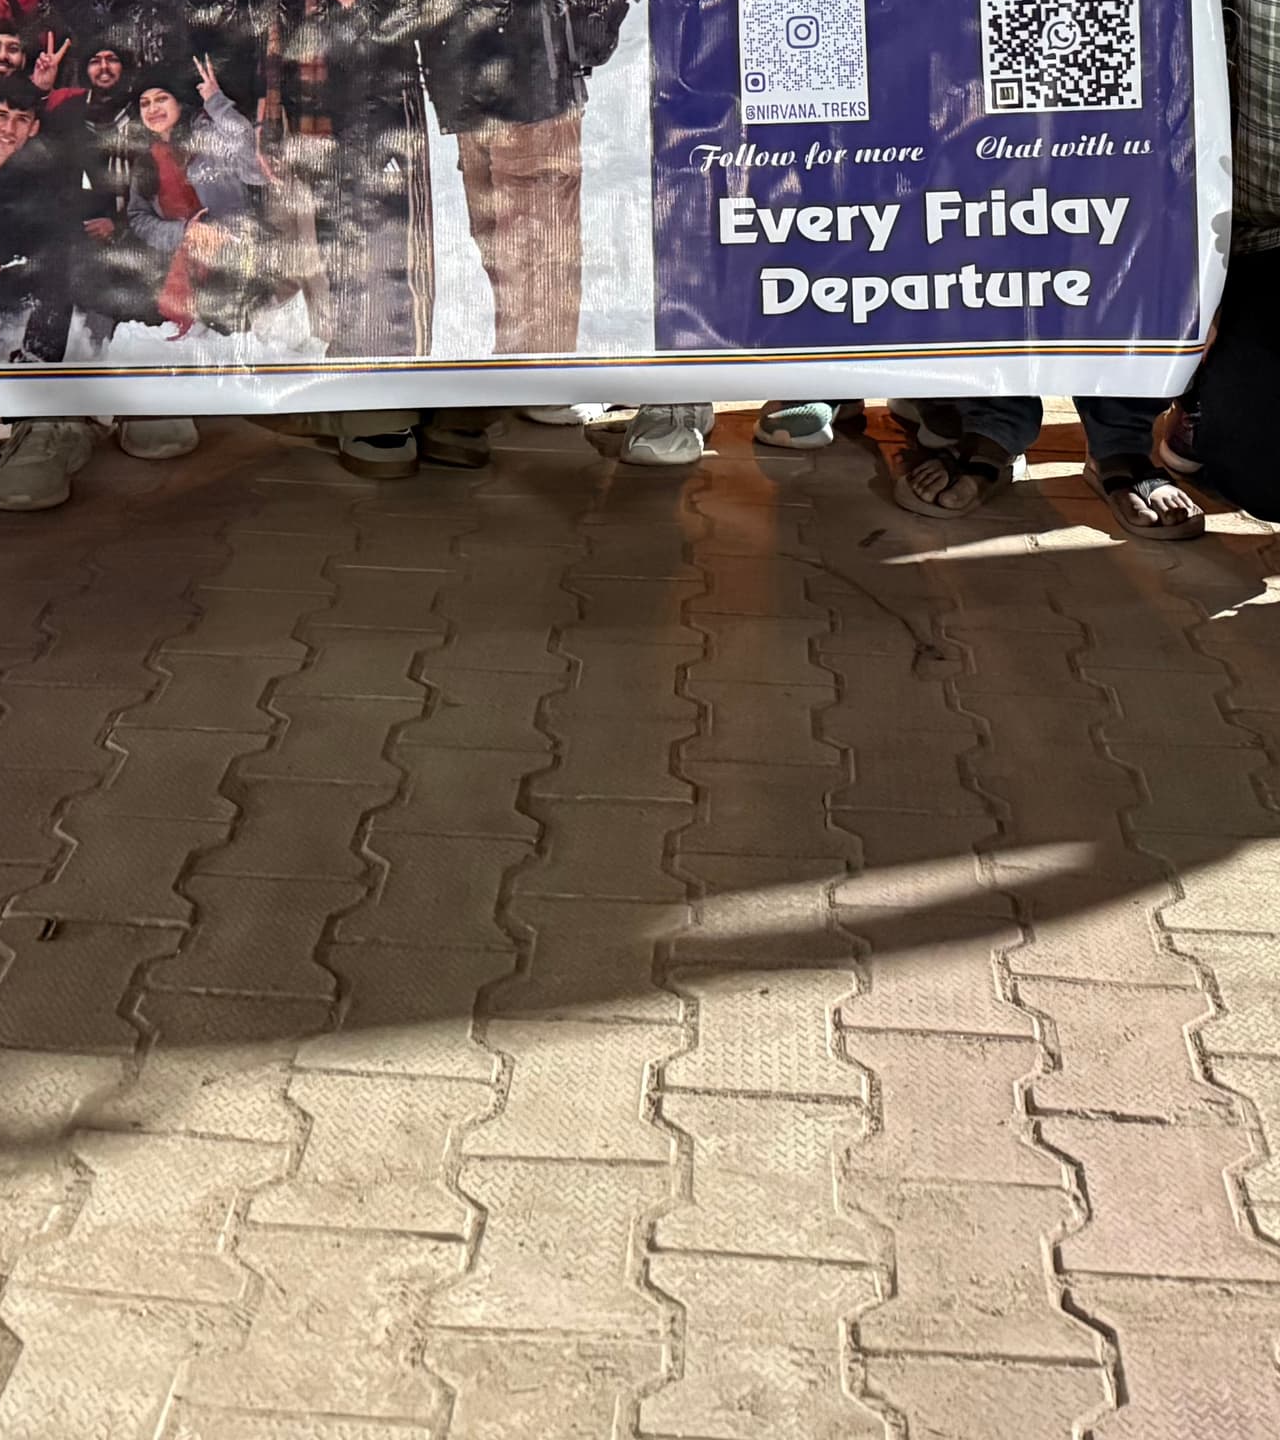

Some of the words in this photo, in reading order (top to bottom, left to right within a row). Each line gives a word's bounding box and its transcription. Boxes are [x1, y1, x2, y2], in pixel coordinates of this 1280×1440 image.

[745, 101, 867, 120] @NIRVANA.TREKS
[689, 143, 797, 173] Follow
[805, 141, 847, 171] for
[854, 145, 926, 164] more
[976, 135, 1043, 160] Chat
[1051, 133, 1116, 158] with
[1123, 139, 1154, 155] us
[719, 196, 901, 252] Every
[925, 188, 1130, 245] Friday
[760, 264, 1091, 324] Departure
